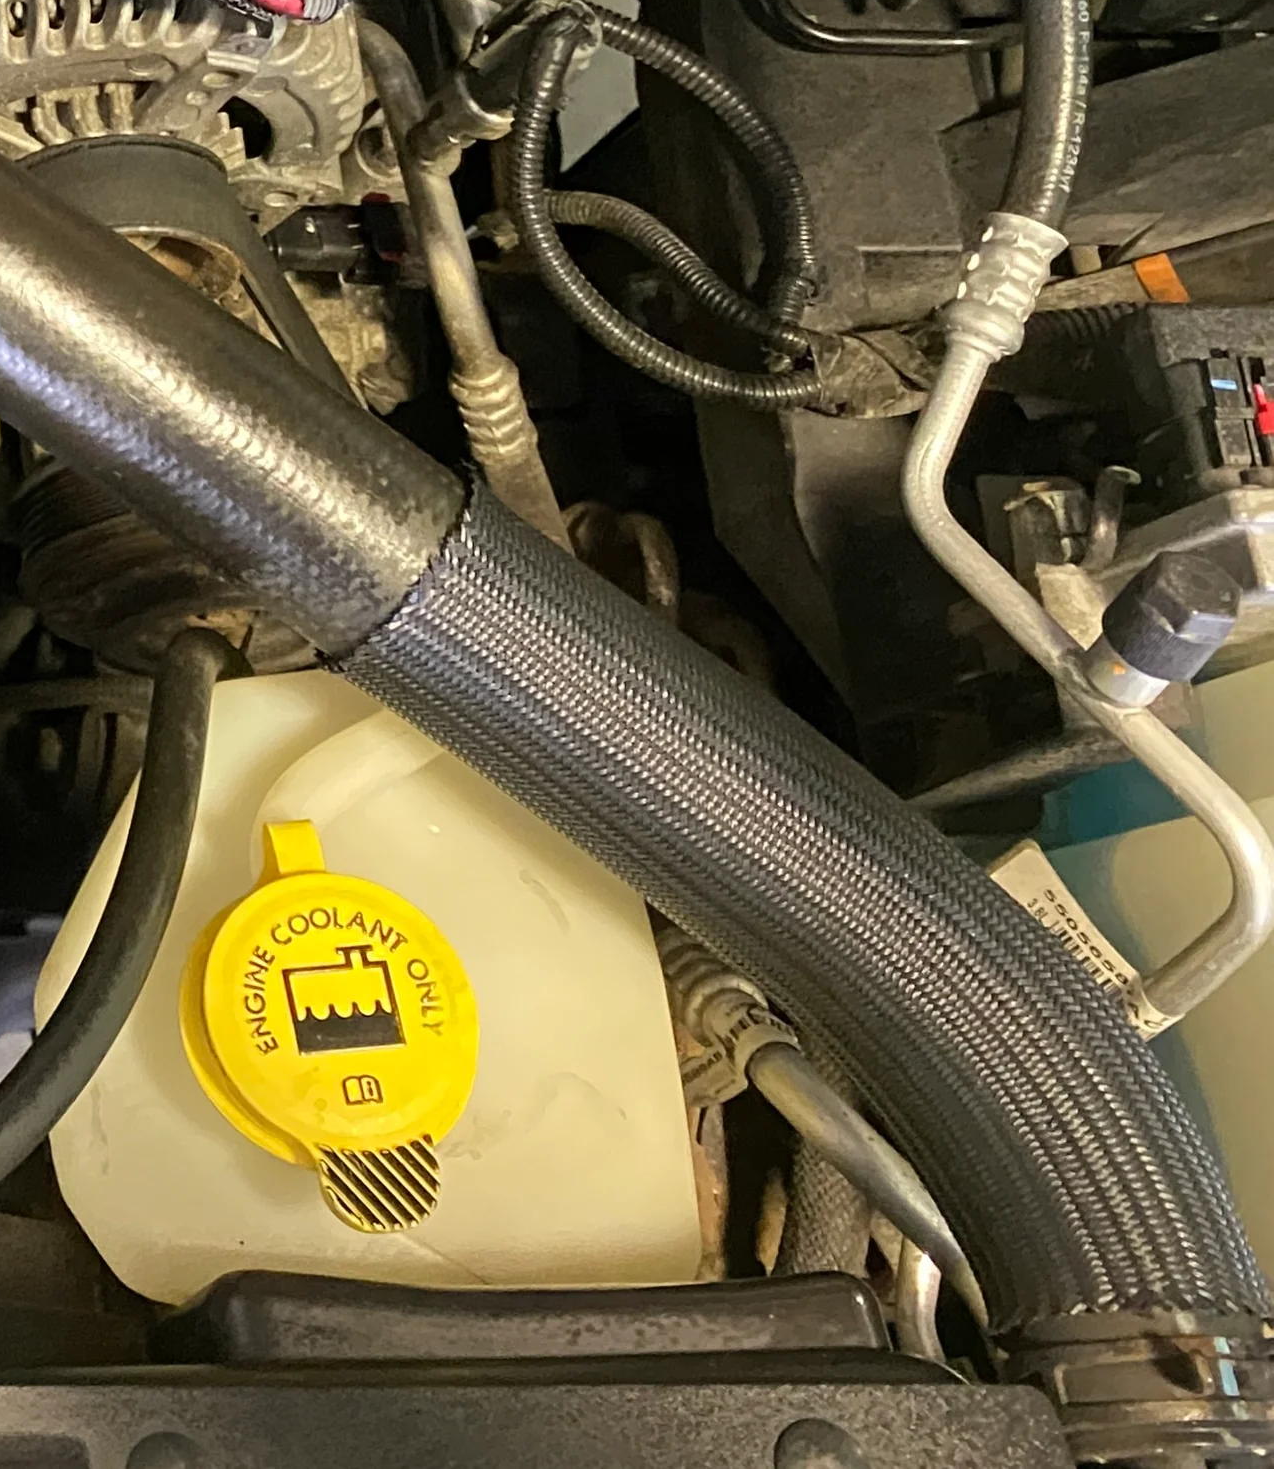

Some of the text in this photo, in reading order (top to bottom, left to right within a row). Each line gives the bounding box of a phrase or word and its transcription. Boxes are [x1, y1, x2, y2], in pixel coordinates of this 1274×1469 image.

[1074, 29, 1092, 95] R-134a
[242, 906, 445, 1056] ENGINE COOLANT ONLY
